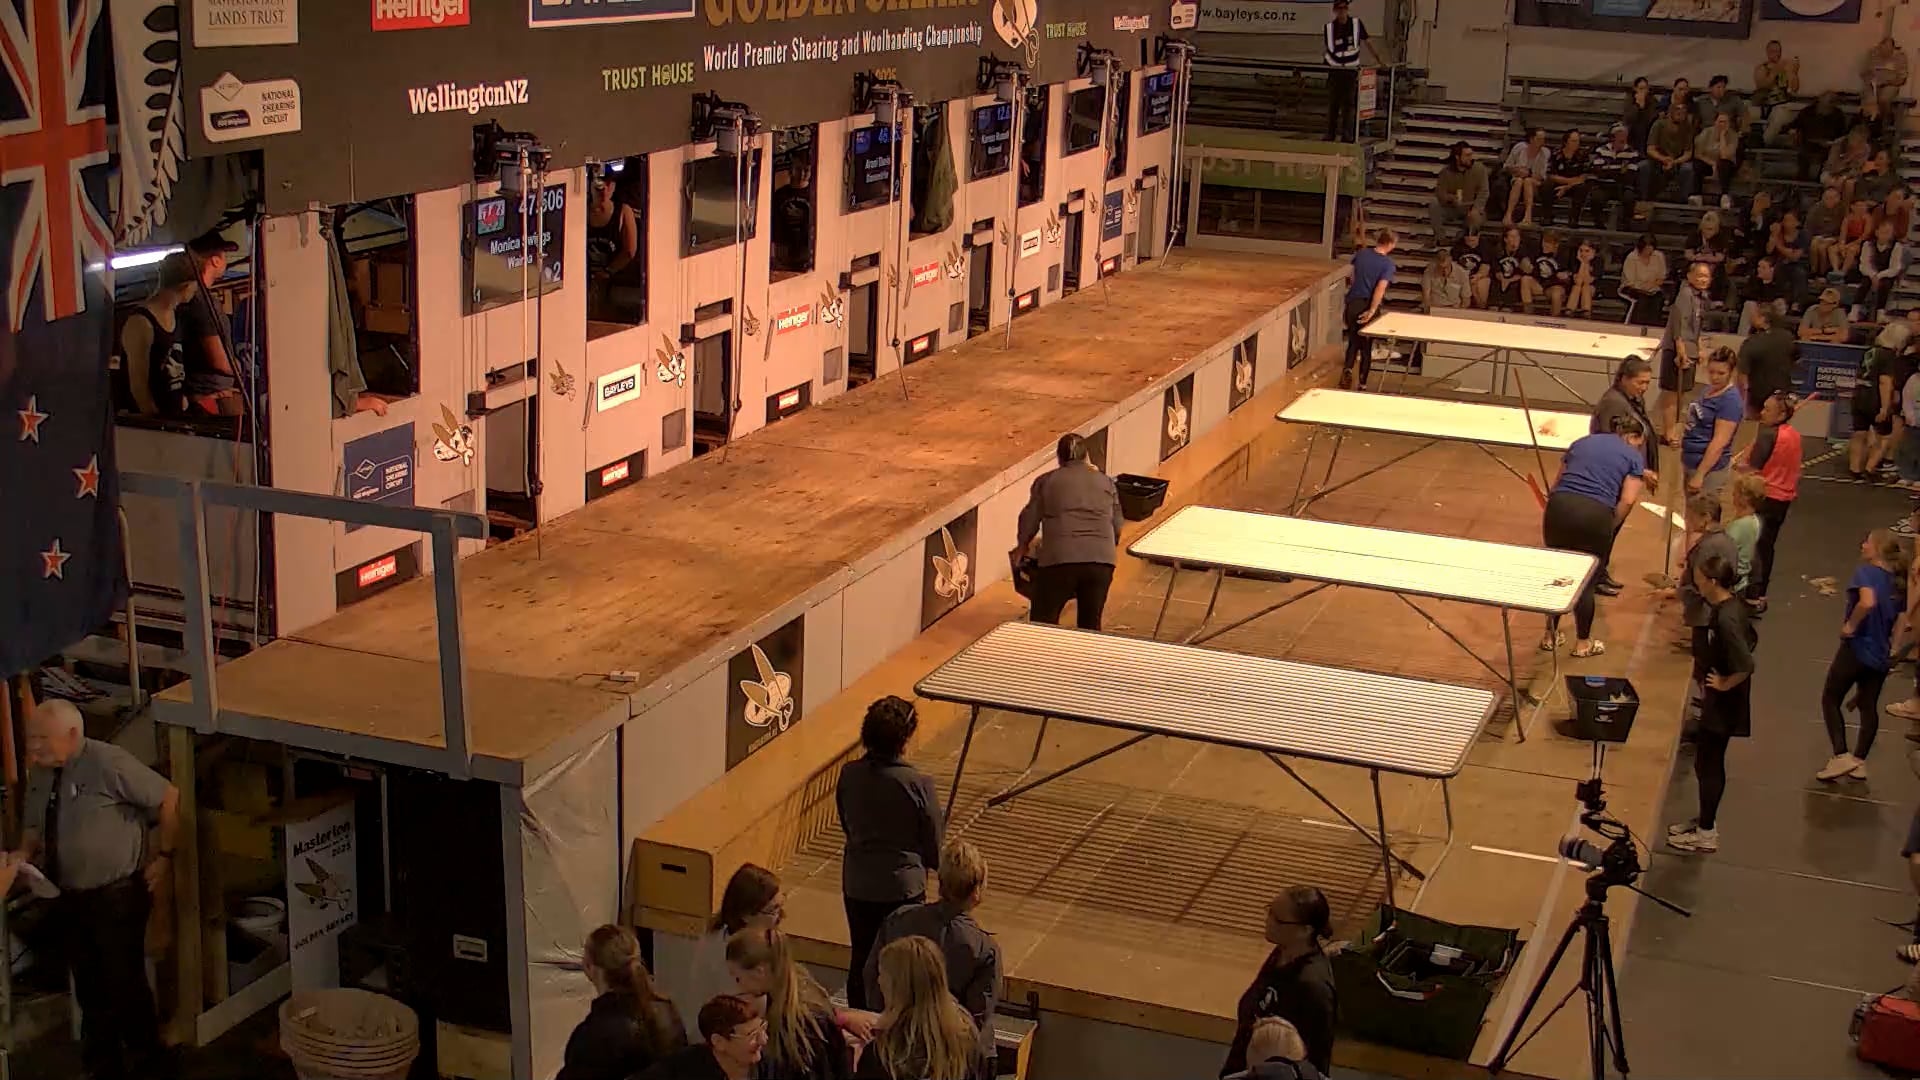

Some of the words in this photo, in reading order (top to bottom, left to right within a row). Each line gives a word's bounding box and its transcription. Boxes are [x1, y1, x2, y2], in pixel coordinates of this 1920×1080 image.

[209, 11, 247, 25] LANDS
[250, 10, 285, 24] TRUST
[703, 43, 739, 72] World
[744, 40, 788, 68] Premier
[791, 37, 839, 62] Shearing
[842, 32, 860, 55] and
[862, 26, 924, 53] Woolhandling
[925, 21, 982, 51] Championship
[602, 66, 646, 91] TRUST
[652, 62, 694, 86] HOUSE
[262, 89, 294, 101] NATIONAL
[408, 79, 528, 115] WellingtonNZ
[490, 237, 520, 255] Monica
[553, 261, 562, 282] 2
[604, 377, 635, 399] BAYLEYS
[293, 822, 351, 857] Masterton
